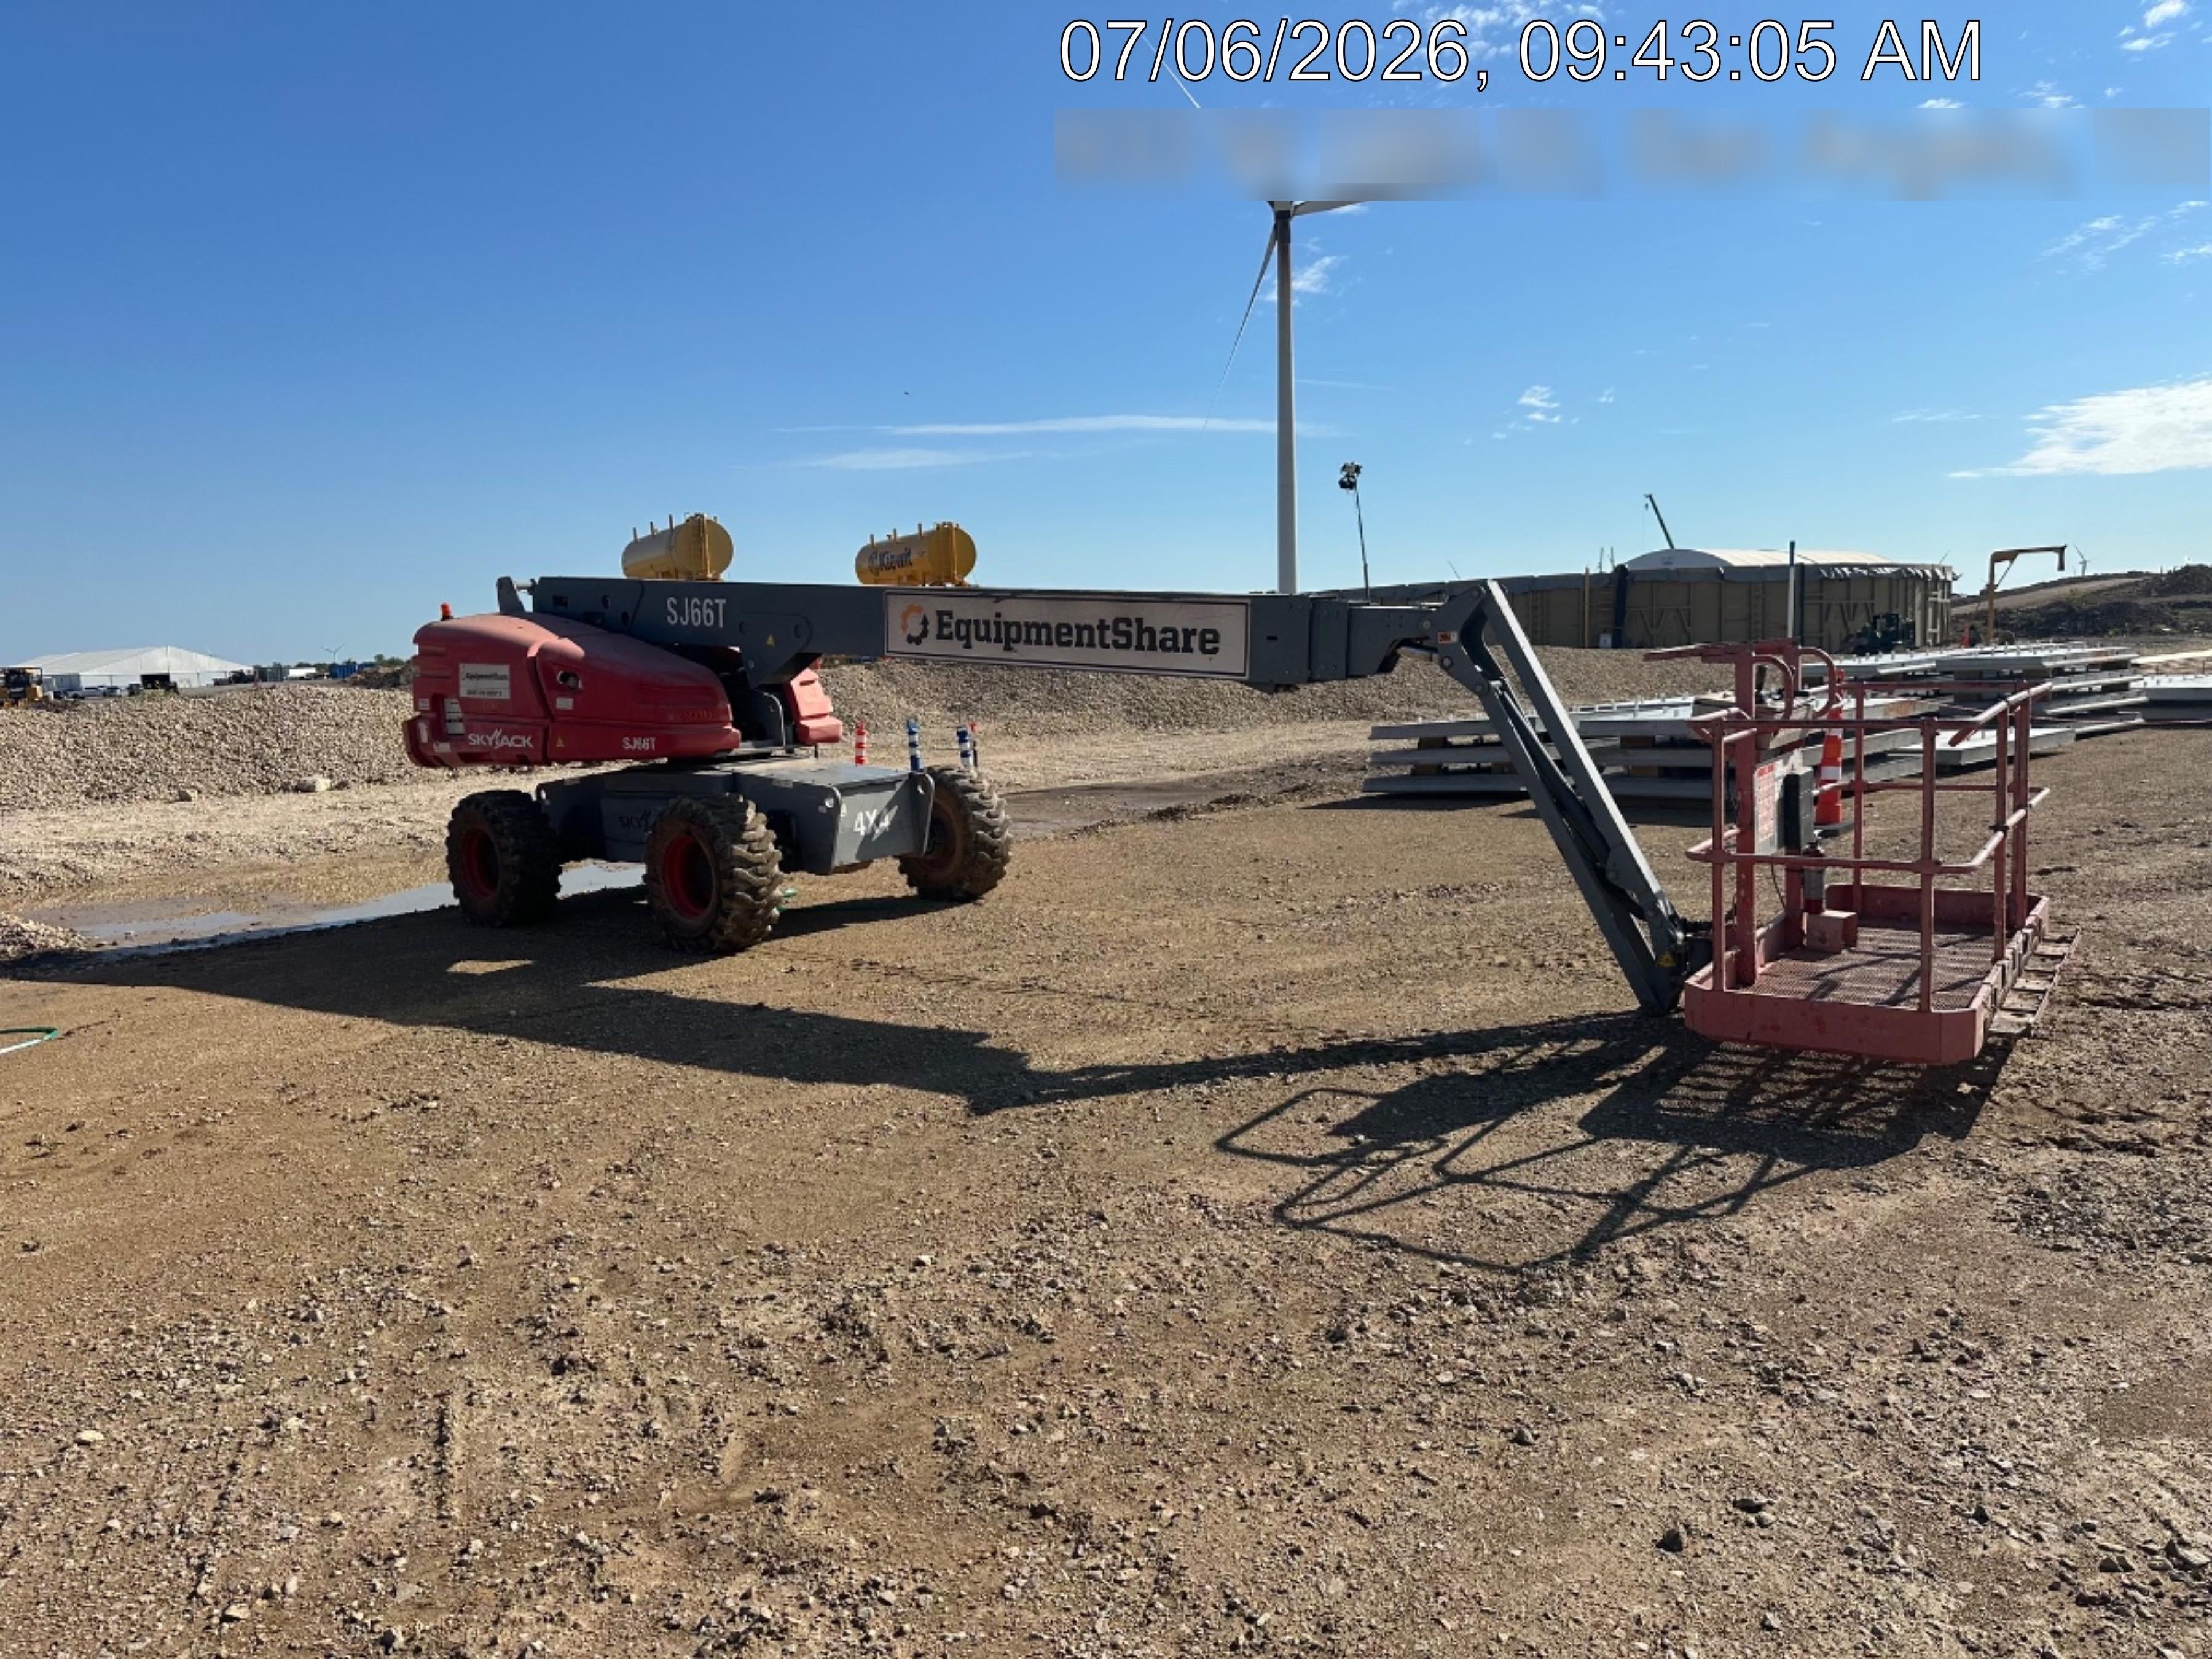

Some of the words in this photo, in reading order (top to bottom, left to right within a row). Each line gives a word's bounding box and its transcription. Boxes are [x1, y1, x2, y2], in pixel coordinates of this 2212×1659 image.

[667, 597, 727, 628] SJ66T
[935, 610, 1220, 655] EquipmentShare
[468, 728, 534, 749] SKYJACK
[622, 737, 656, 750] SJ66T
